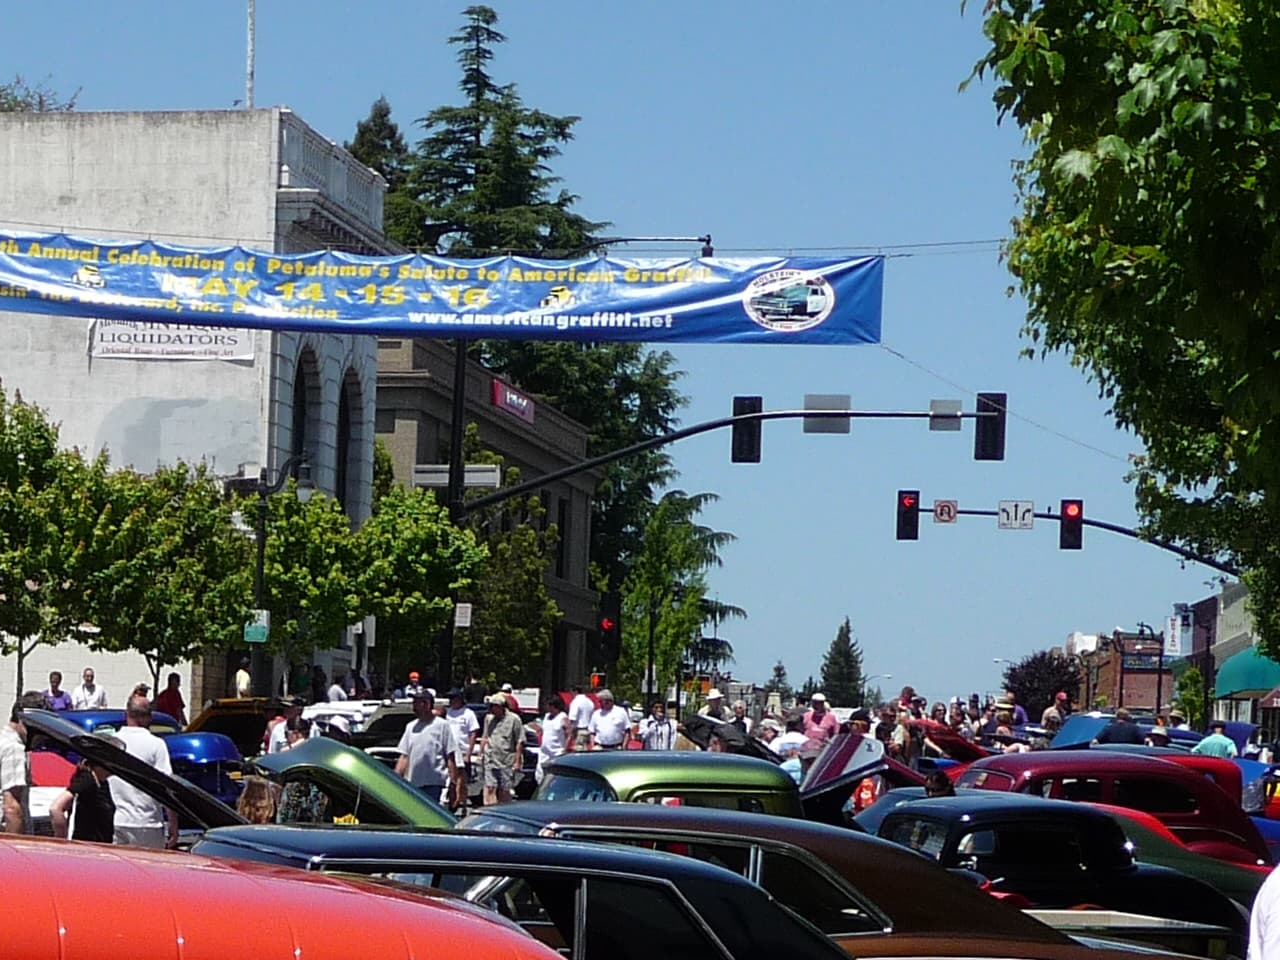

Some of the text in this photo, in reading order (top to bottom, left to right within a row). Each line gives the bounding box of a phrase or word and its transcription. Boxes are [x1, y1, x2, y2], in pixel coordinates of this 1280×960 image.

[27, 243, 99, 261] Annual
[107, 249, 225, 272] Celebration
[233, 257, 255, 273] of
[267, 258, 389, 278] Petaluma's
[398, 264, 469, 281] Salute
[477, 267, 500, 281] to
[508, 267, 615, 283] American
[161, 272, 259, 298] MAY
[275, 281, 323, 302] 14
[360, 283, 406, 305] 15
[446, 286, 490, 308] 16
[408, 311, 673, 329] www.americangraffiti.net
[100, 332, 238, 346] LIQUIDATORS
